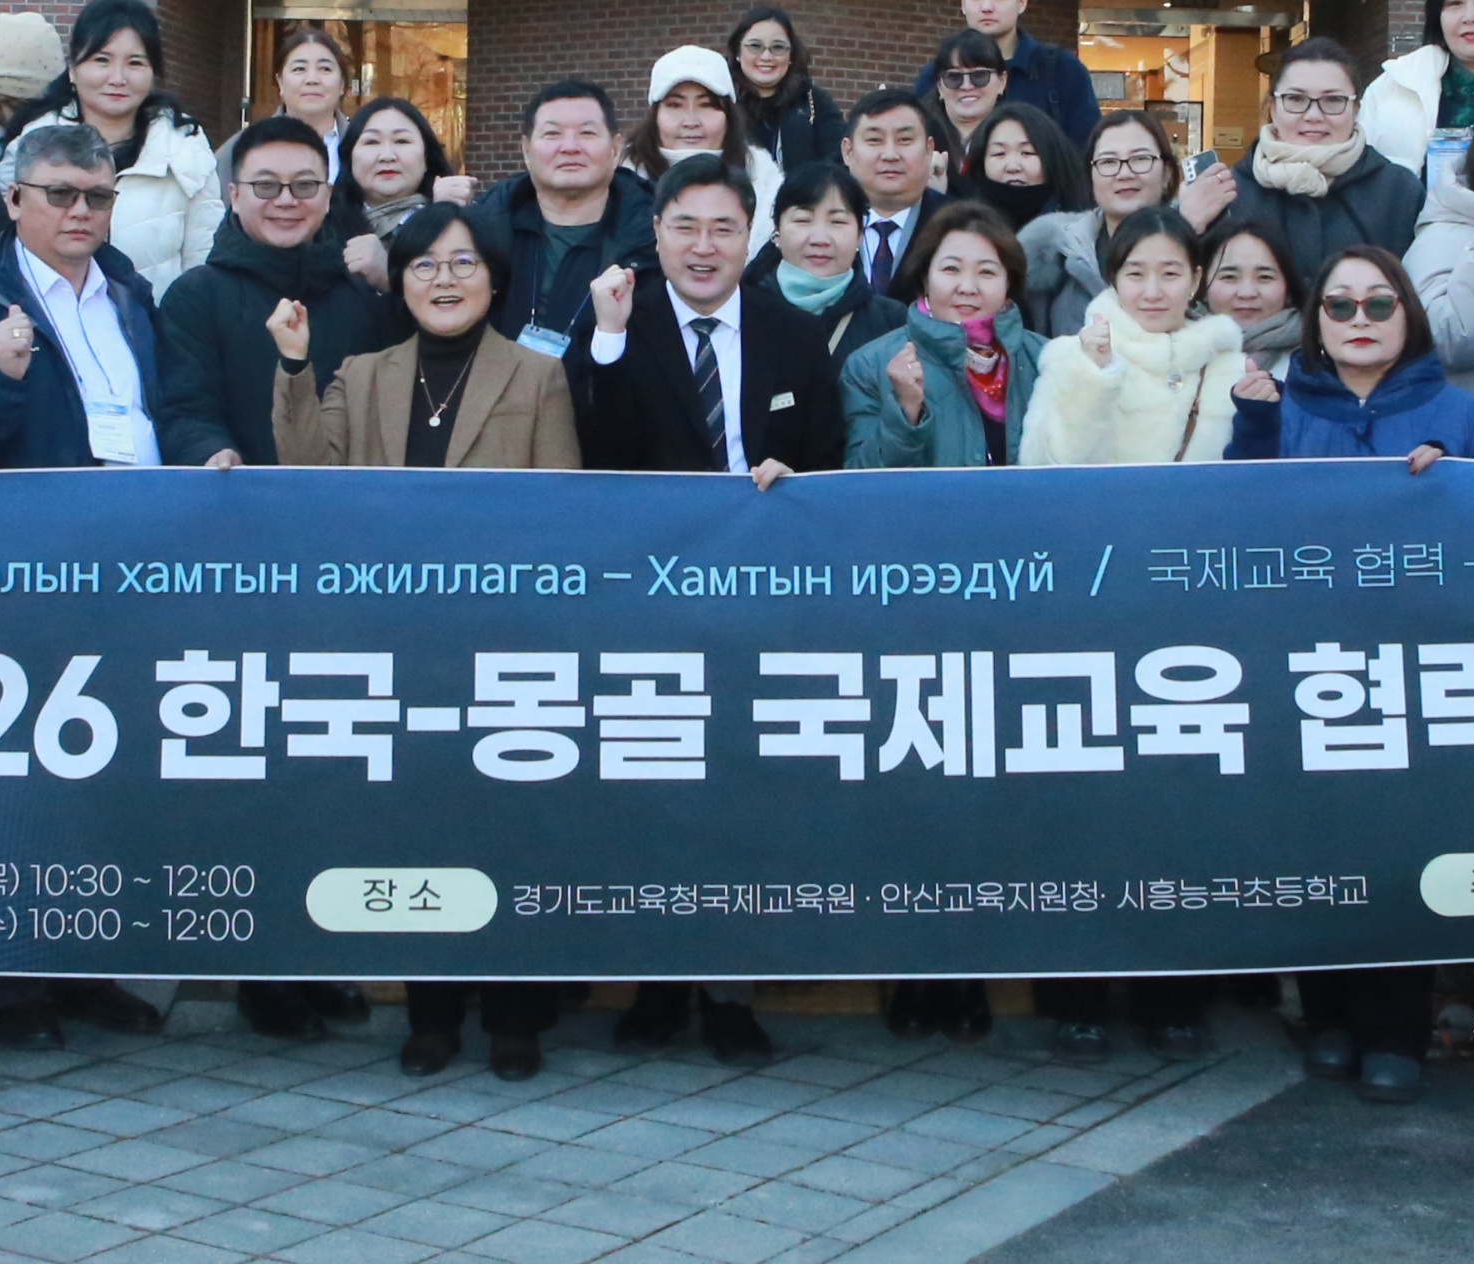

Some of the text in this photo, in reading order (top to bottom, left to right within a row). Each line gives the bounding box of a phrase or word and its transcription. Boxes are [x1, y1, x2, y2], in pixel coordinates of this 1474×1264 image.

[117, 561, 298, 594] хамтын
[316, 562, 586, 596] ажиллагаа
[647, 555, 832, 596] Хамтын
[852, 551, 1054, 606] ирээдүй
[1147, 545, 1335, 592] 국제교육
[1353, 542, 1444, 588] 협력
[155, 650, 712, 782] 한국-몽골
[752, 645, 1250, 780] 국제교육
[30, 863, 123, 897] 10:30
[162, 864, 255, 898] 12:00
[513, 883, 855, 916] 경기도교육청국제교육원
[1117, 875, 1368, 911] 시흥능곡초등학교
[28, 907, 121, 941] 10:00
[162, 908, 254, 942] 12:00
